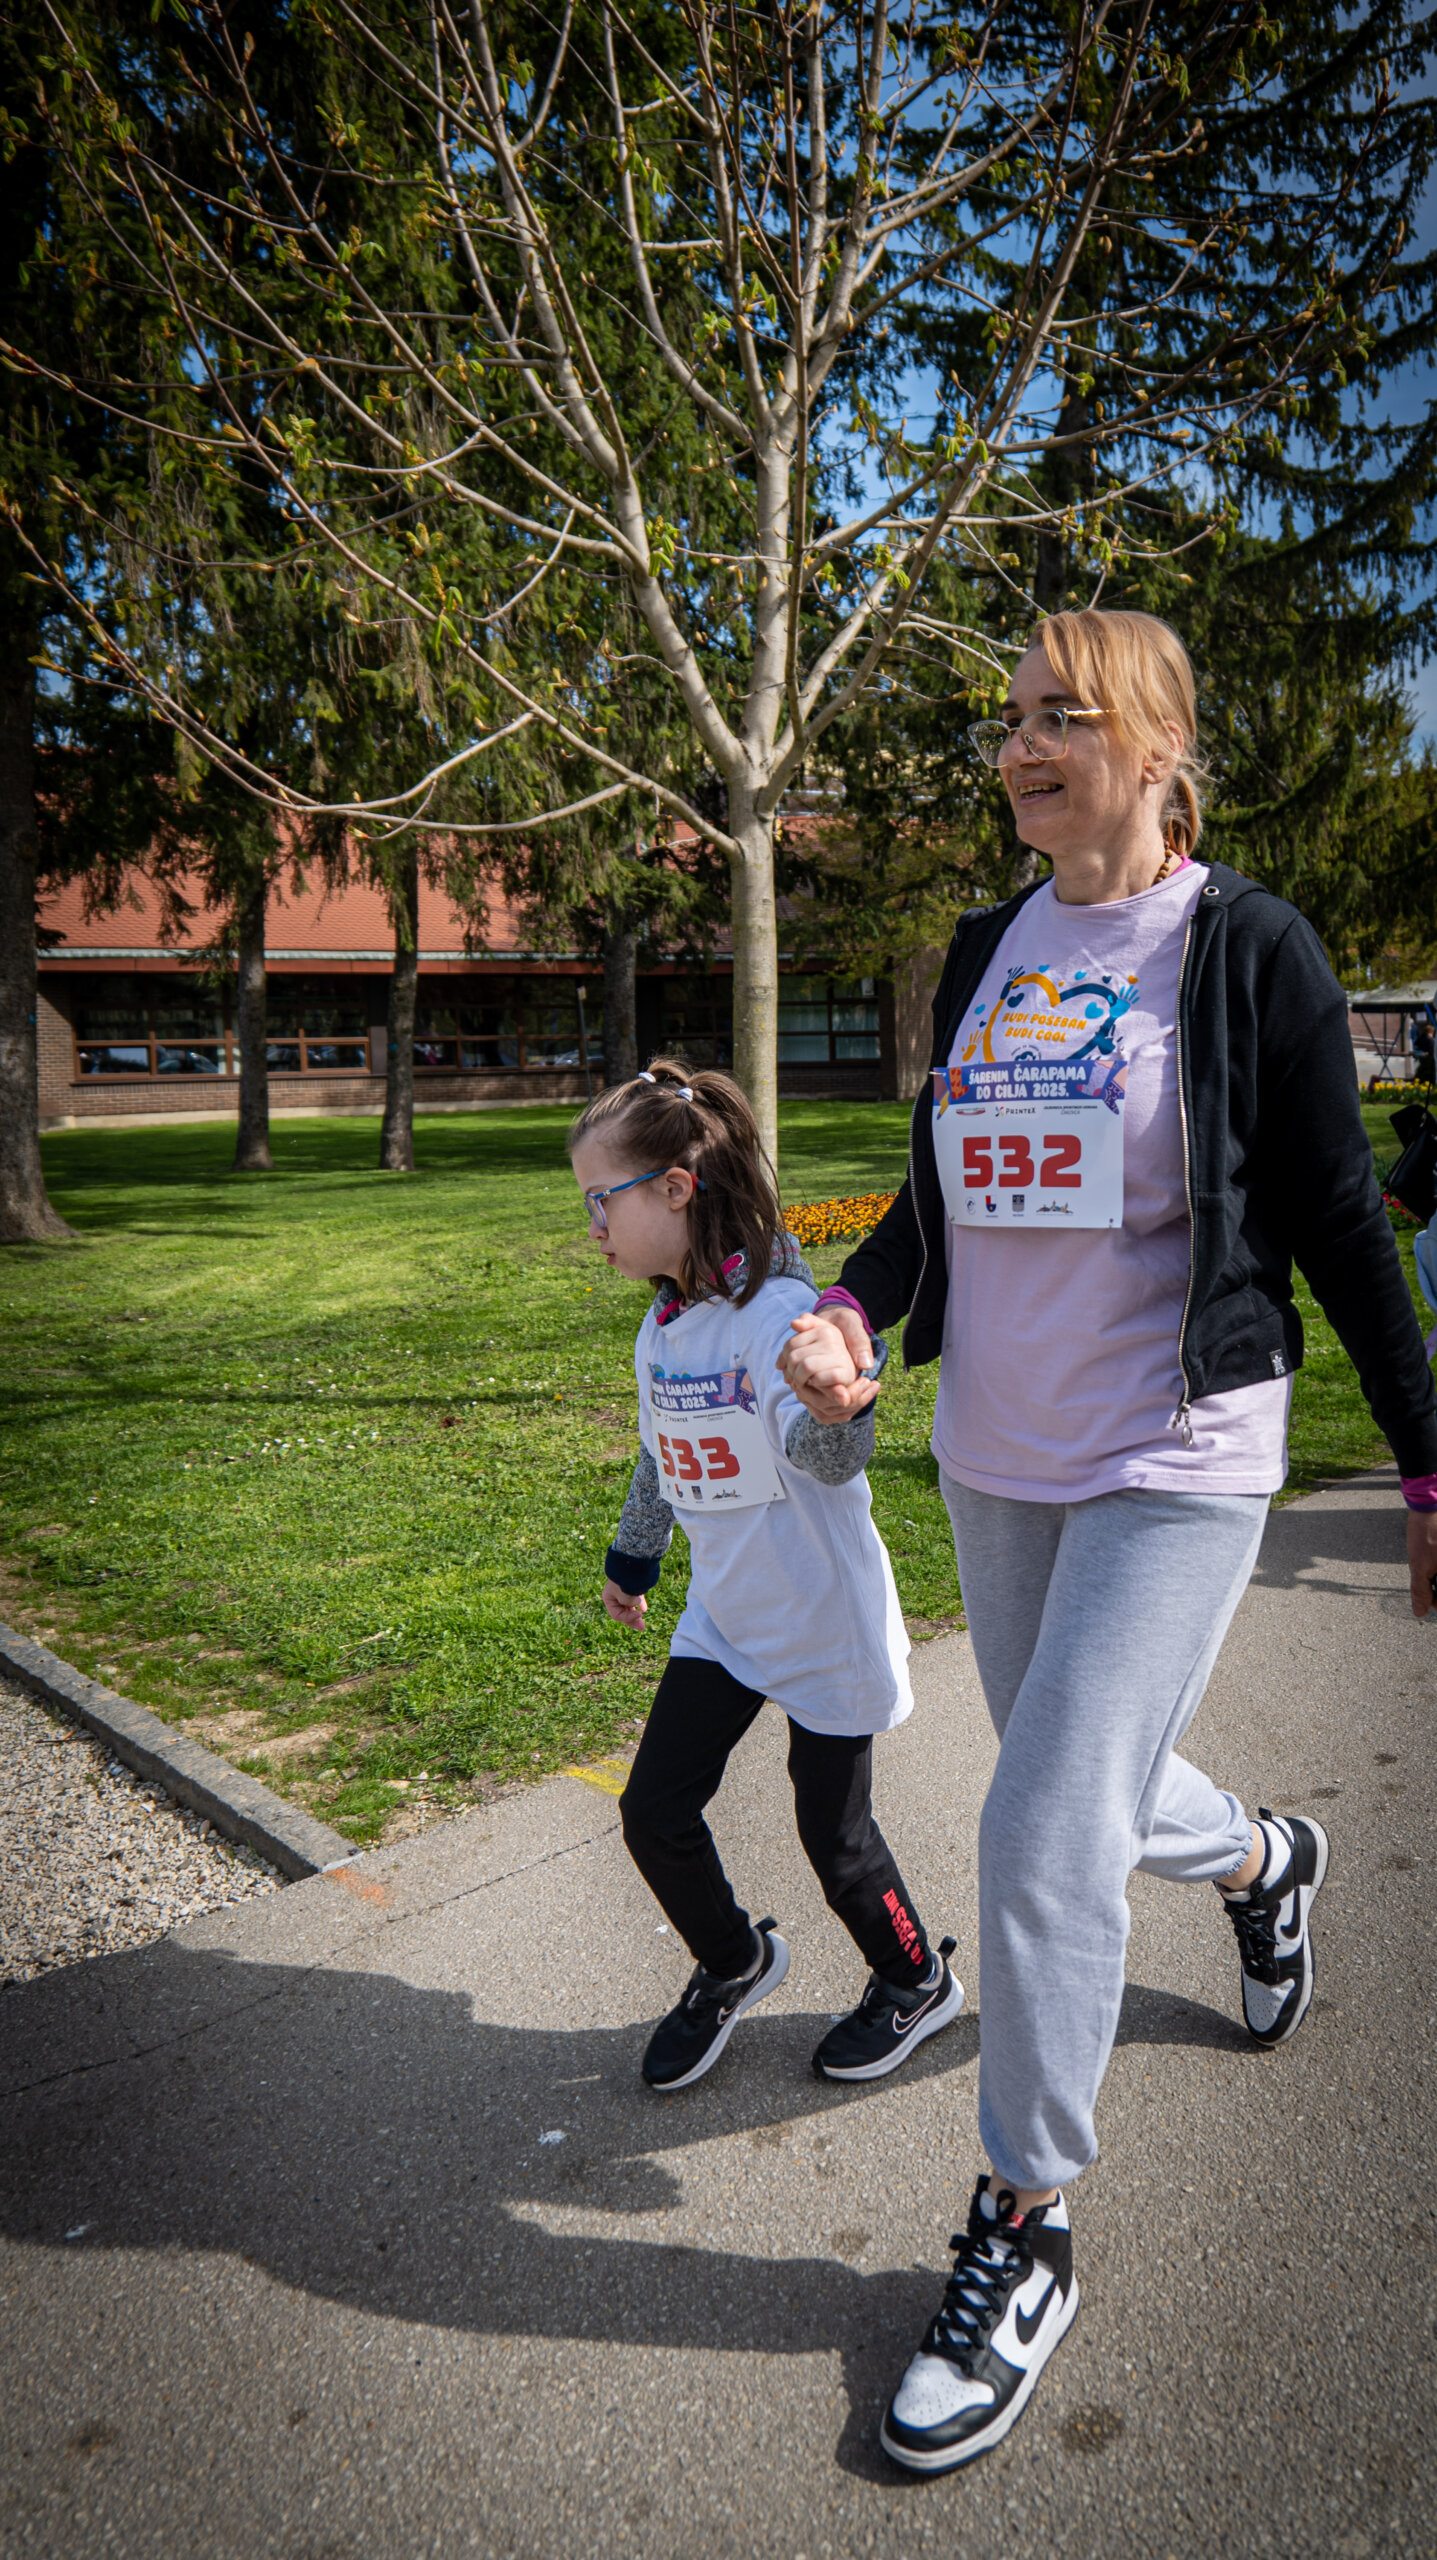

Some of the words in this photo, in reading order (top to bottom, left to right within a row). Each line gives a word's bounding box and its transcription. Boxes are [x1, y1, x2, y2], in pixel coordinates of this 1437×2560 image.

[1002, 1012, 1029, 1023] BUDI
[1030, 1013, 1087, 1030] POSEBAN
[1004, 1026, 1034, 1039] BUDI
[1035, 1029, 1067, 1043] COOL
[968, 1069, 1009, 1085] ŠARENIM
[1013, 1064, 1086, 1081] ČARAPAMA
[976, 1086, 991, 1100] DO
[995, 1084, 1029, 1098] CILJA
[1032, 1082, 1069, 1098] 2025.
[962, 1134, 1082, 1188] 532
[680, 1395, 710, 1410] 2025.
[657, 1432, 740, 1481] 533
